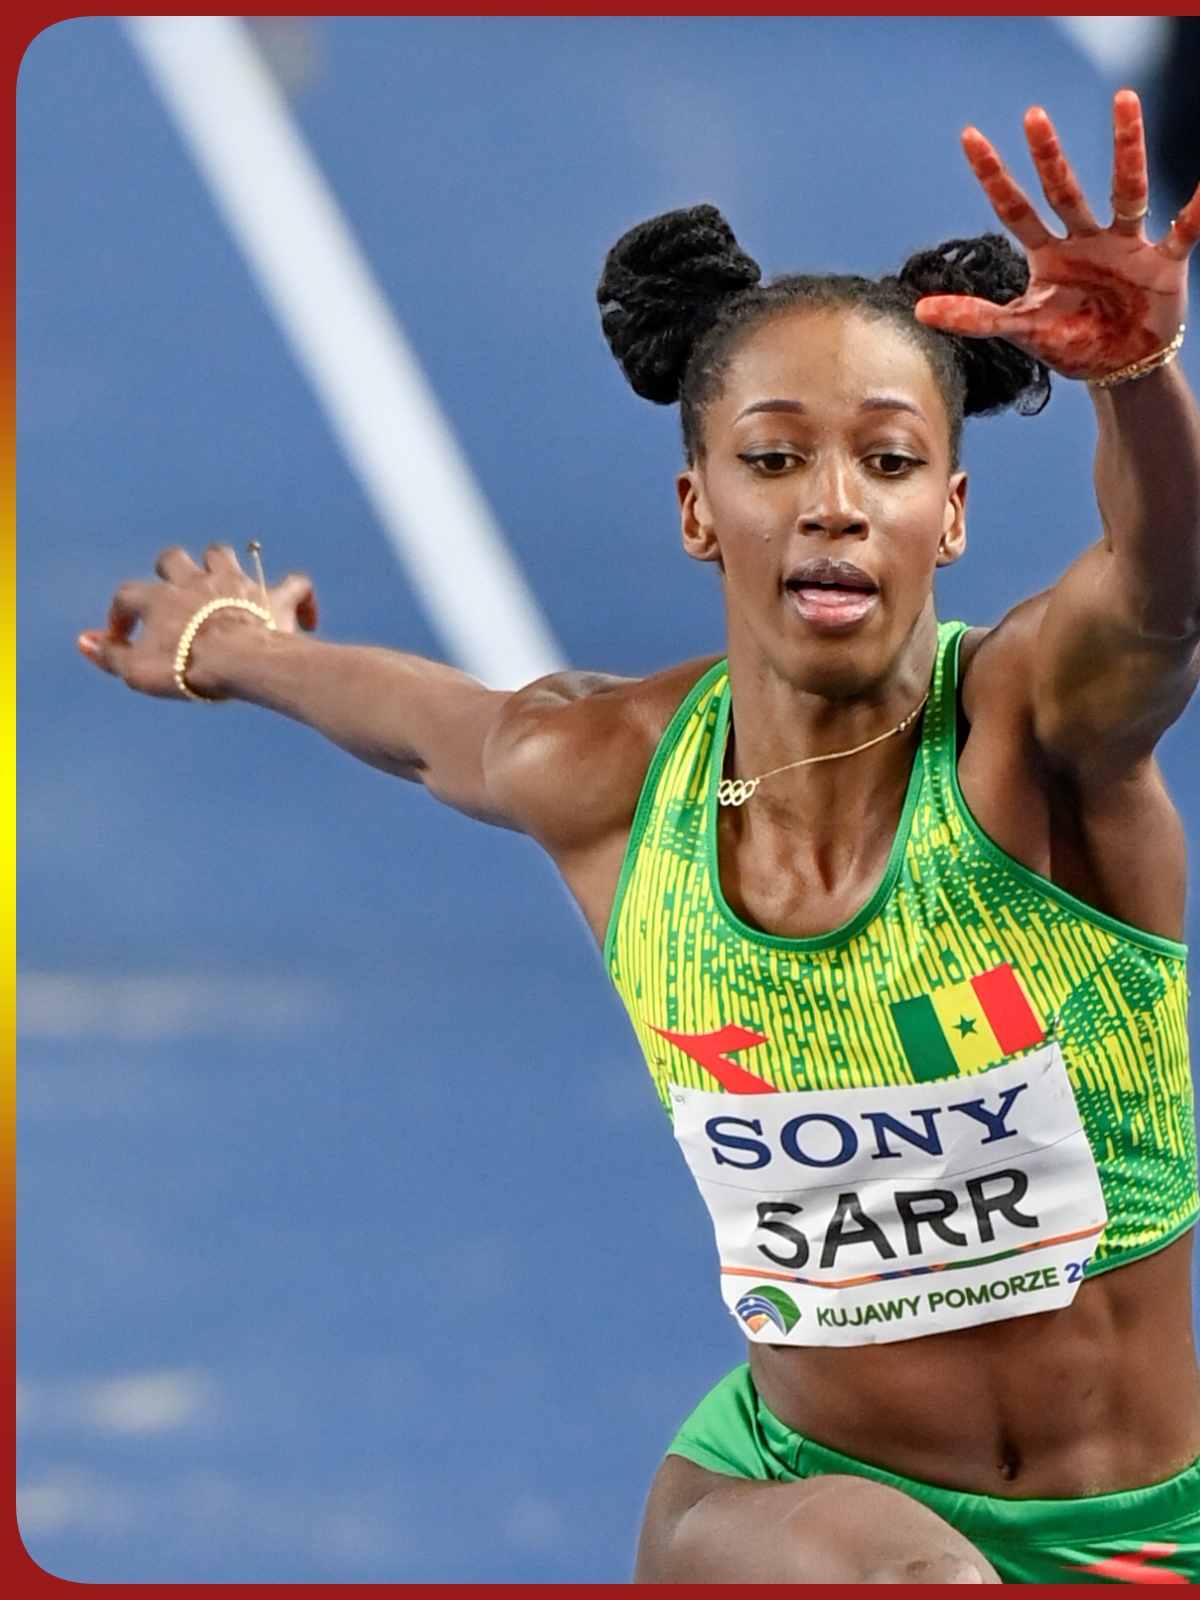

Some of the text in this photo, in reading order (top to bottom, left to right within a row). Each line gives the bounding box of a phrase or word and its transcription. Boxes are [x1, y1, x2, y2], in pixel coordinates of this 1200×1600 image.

[705, 1083, 1028, 1170] SONY
[816, 1295, 920, 1327] KUJAWY
[929, 1266, 1060, 1312] POMORZE
